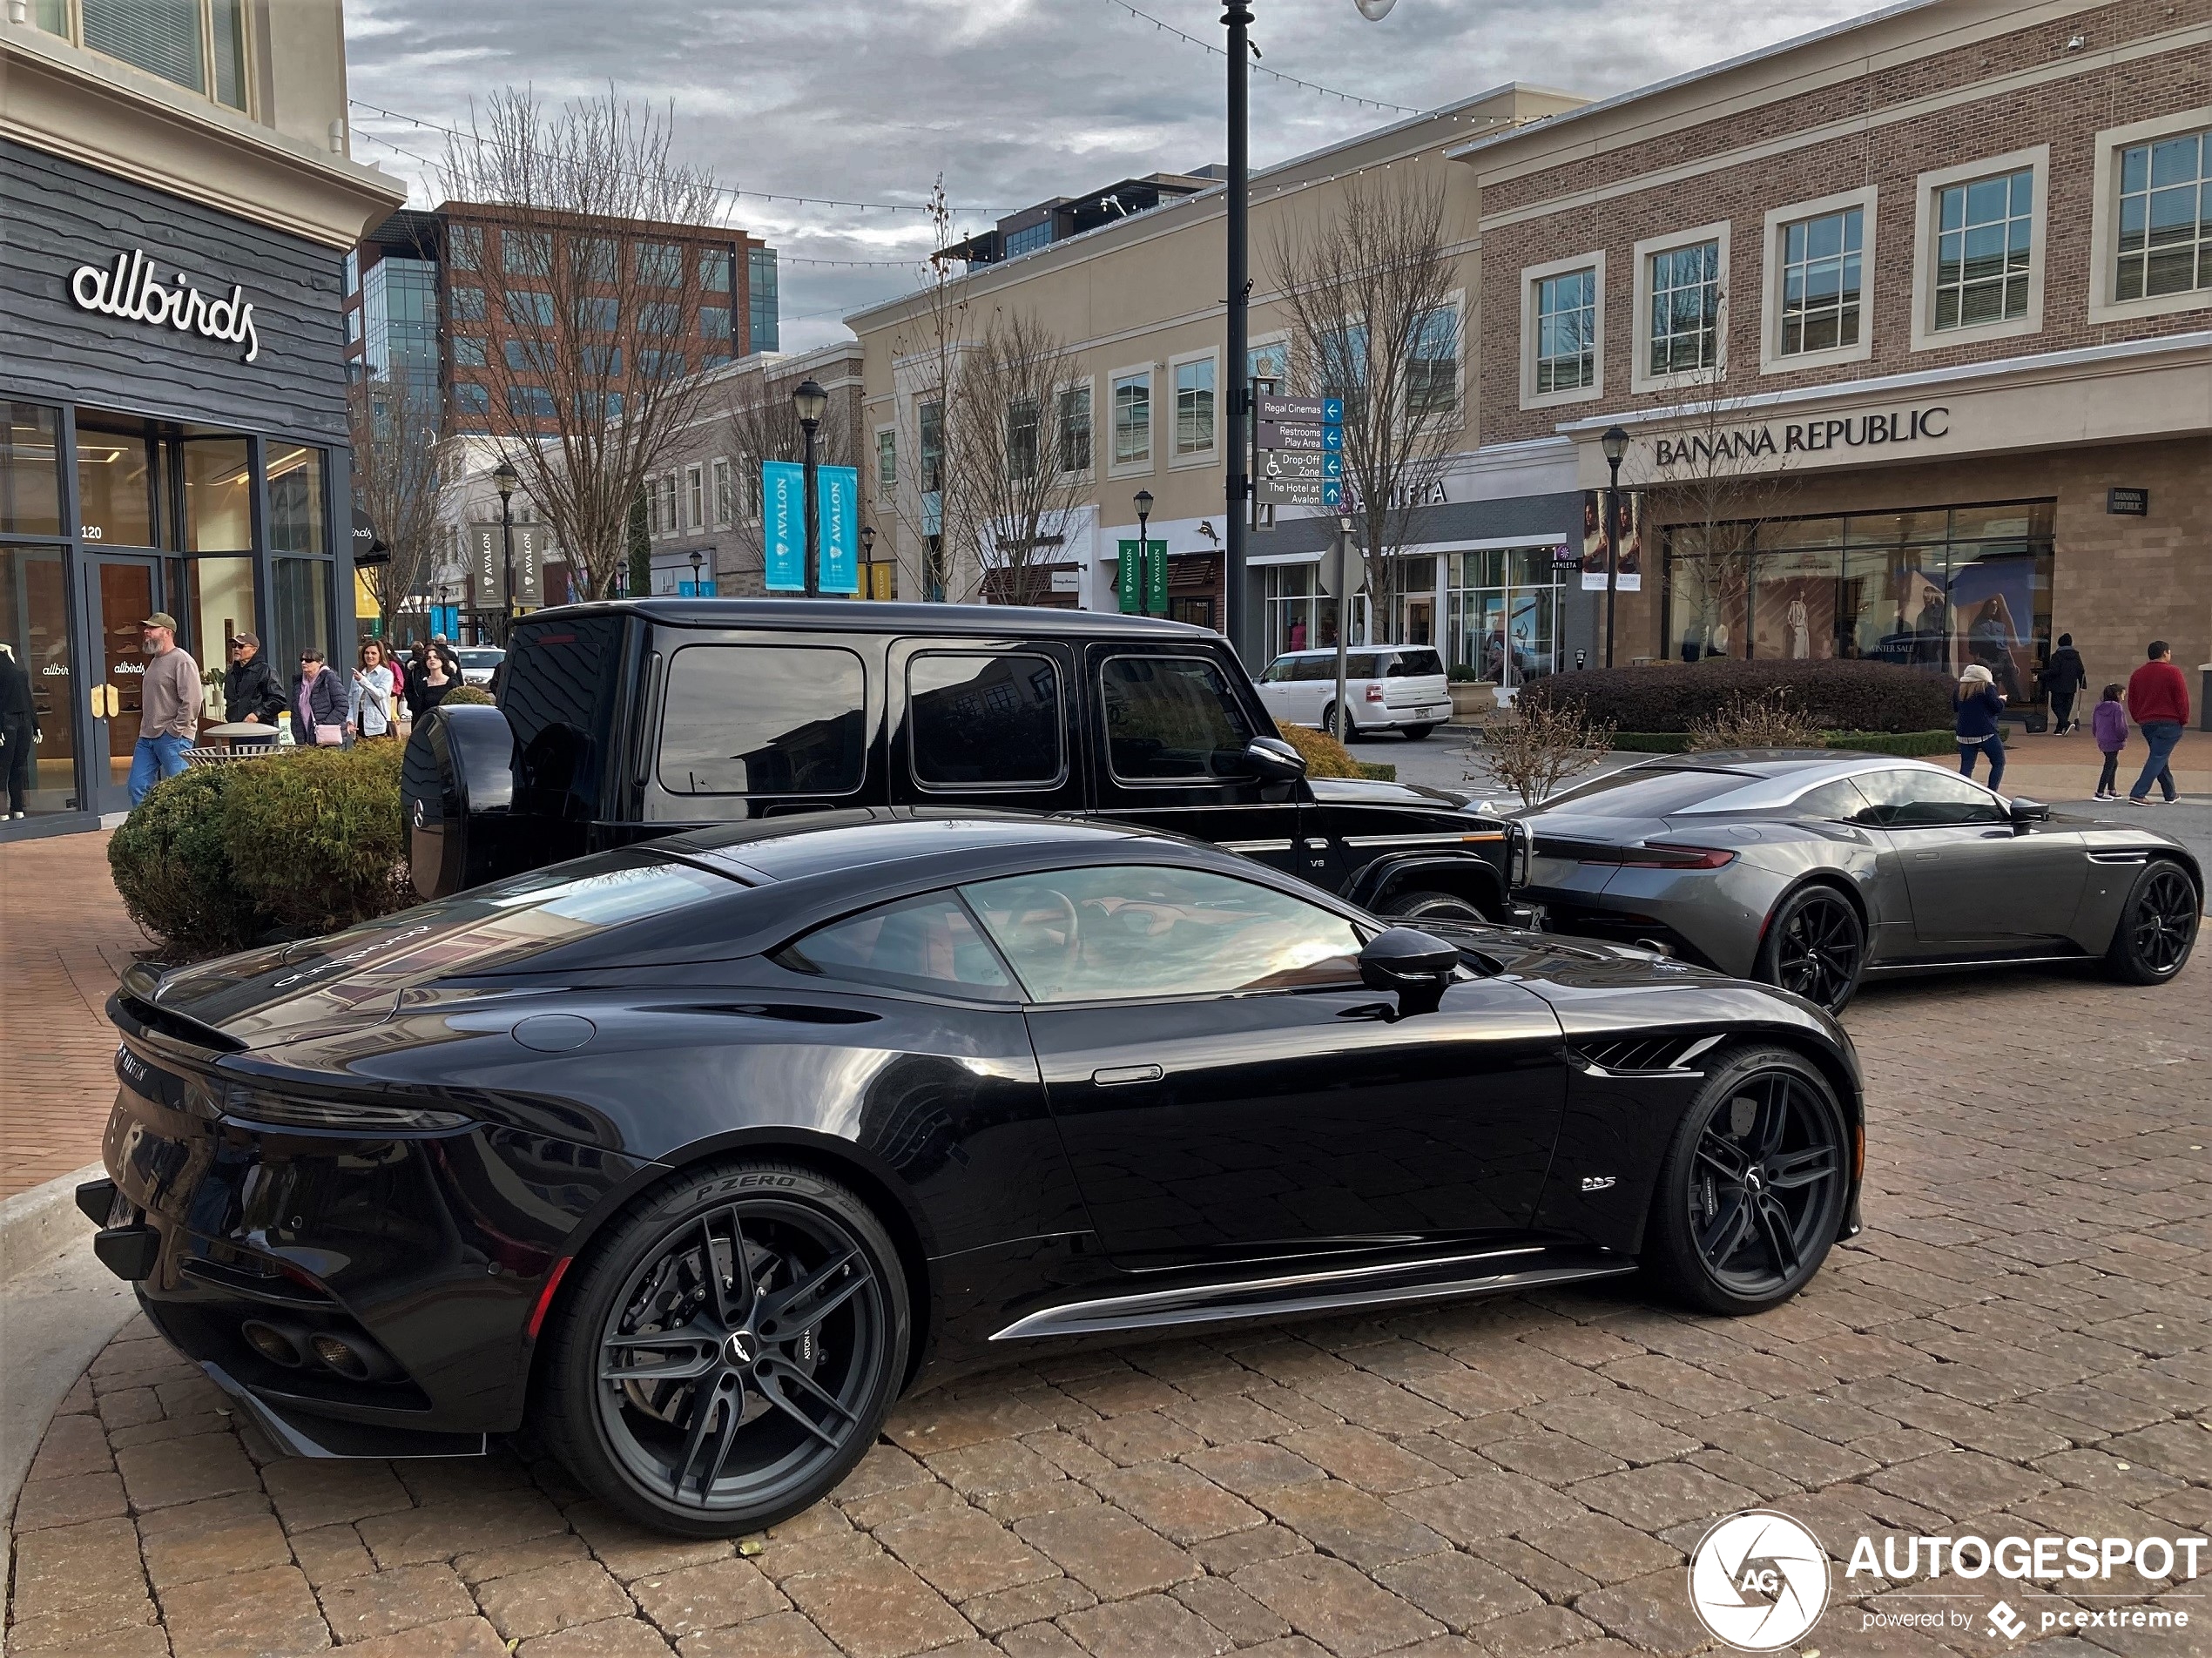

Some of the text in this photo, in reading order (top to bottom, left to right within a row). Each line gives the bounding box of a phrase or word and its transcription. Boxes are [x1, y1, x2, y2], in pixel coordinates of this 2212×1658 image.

[71, 248, 259, 362] allbirds
[1264, 402, 1321, 414] Regal Cinemas
[1279, 426, 1321, 437] Restrooms
[1656, 407, 1949, 466] BANANA REPUBLIC
[1285, 437, 1321, 448] Play Area
[1283, 455, 1320, 466] Drop-Off
[1298, 467, 1320, 476] Zone
[1269, 482, 1320, 493] The Hotel at
[1291, 494, 1319, 503] Avalon
[777, 477, 787, 540] AVALON
[831, 482, 841, 543] AVALON
[81, 525, 102, 539] 120
[482, 532, 493, 575] AVALON
[523, 532, 533, 575] AVALON
[114, 660, 145, 677] allbirds
[696, 1175, 797, 1202] P ZERO
[1581, 1176, 1616, 1191] DBS
